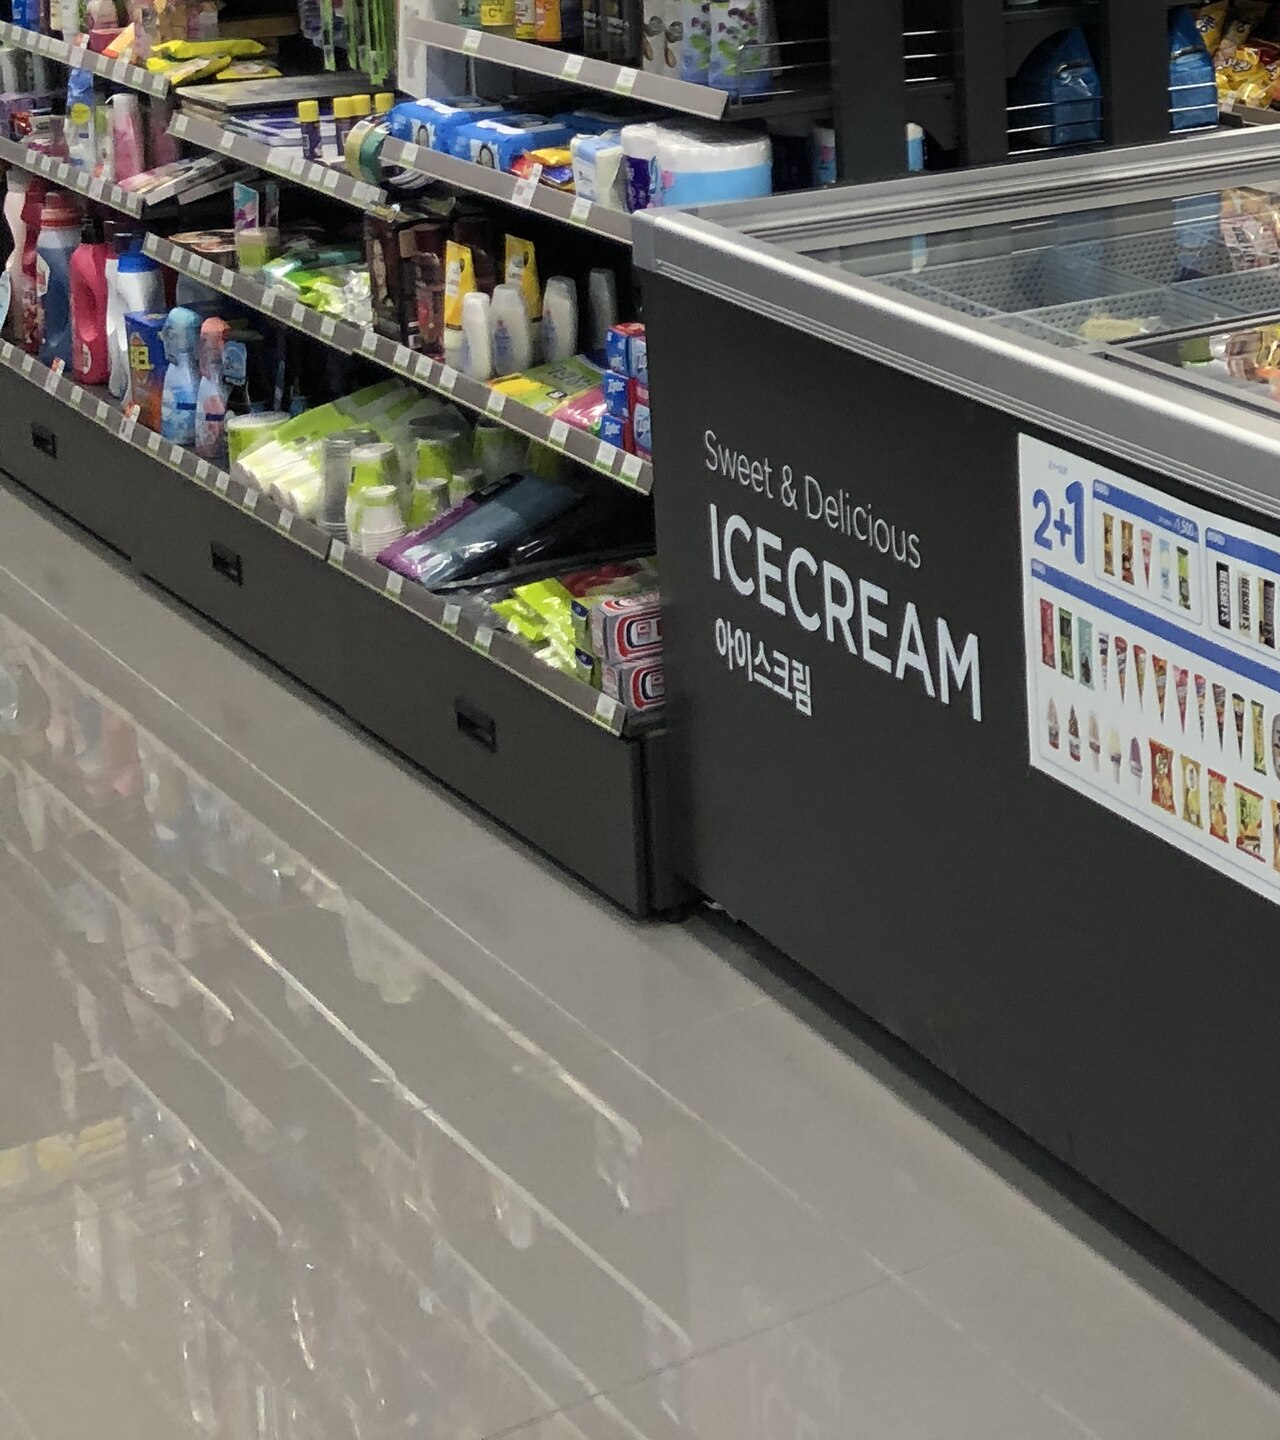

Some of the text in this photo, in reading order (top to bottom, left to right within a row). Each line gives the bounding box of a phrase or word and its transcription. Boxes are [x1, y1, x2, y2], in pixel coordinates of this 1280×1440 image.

[705, 429, 921, 570] Sweet & Delicious
[1033, 480, 1085, 566] 2+1
[709, 503, 982, 723] ICECREAM
[715, 617, 812, 717] 아이스크림
